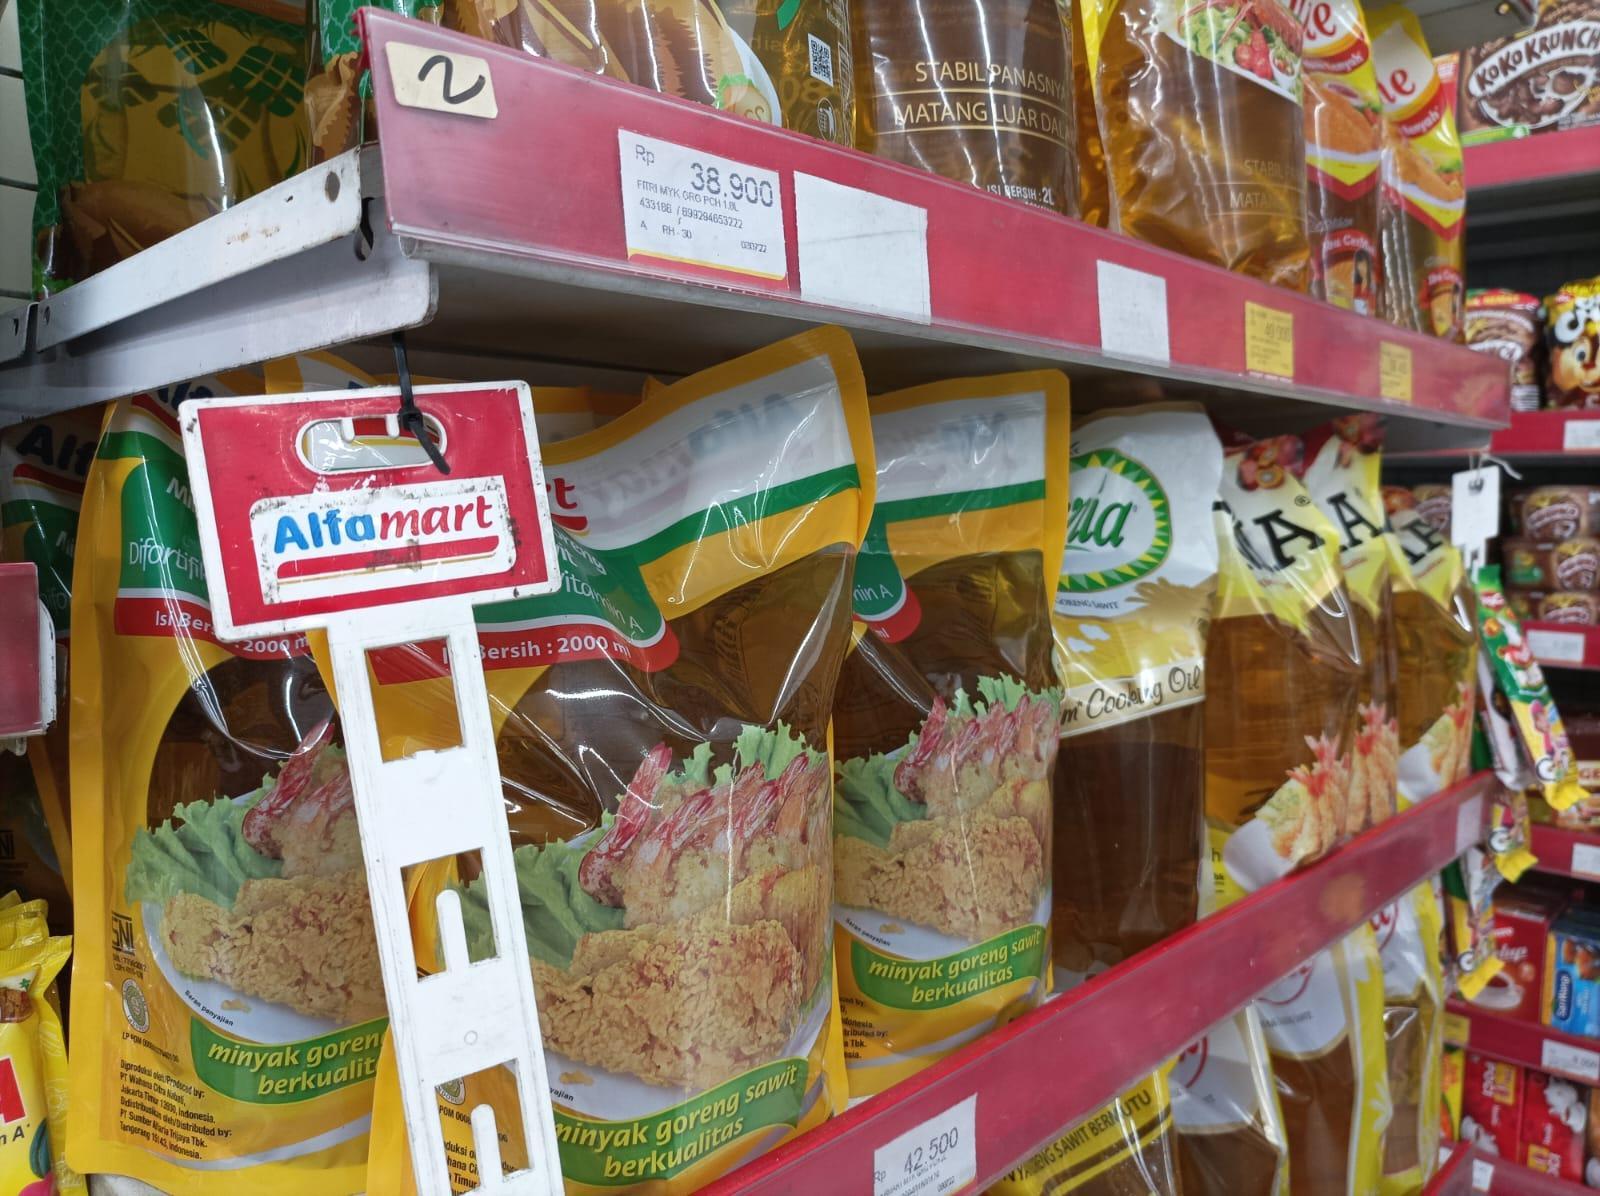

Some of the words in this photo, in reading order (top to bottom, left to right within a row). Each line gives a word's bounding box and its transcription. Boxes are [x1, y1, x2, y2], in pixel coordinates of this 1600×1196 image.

[914, 62, 986, 83] STABIL
[1475, 49, 1523, 91] KOKO
[1523, 26, 1600, 64] KRUNCH
[895, 101, 988, 127] MATANG
[993, 103, 1038, 129] LUAR
[635, 144, 655, 166] Rp
[690, 162, 774, 208] 38.900
[636, 179, 658, 194] FITRI
[659, 184, 680, 198] MYK
[703, 195, 721, 209] PCH
[1004, 184, 1037, 201] BERSIH
[1041, 187, 1054, 206] 2L
[662, 224, 675, 237] RH
[681, 227, 693, 240] 30
[273, 495, 493, 554] Alfamart
[879, 583, 894, 599] A
[243, 640, 291, 653] 2000
[557, 635, 609, 654] 2000
[1168, 665, 1201, 694] Oil
[869, 959, 944, 986] minyak
[948, 945, 1008, 980] goreng
[1011, 927, 1041, 957] sawit
[911, 964, 1014, 1004] berkualitas
[201, 1004, 235, 1027] penyajian
[207, 1041, 300, 1073] minyak
[656, 1091, 740, 1145] goreng
[745, 1065, 798, 1104] sawit
[217, 1128, 233, 1138] by:
[604, 1116, 745, 1179] berkualitas
[1053, 1125, 1090, 1159] SAWIT
[904, 1126, 958, 1175] 42.500
